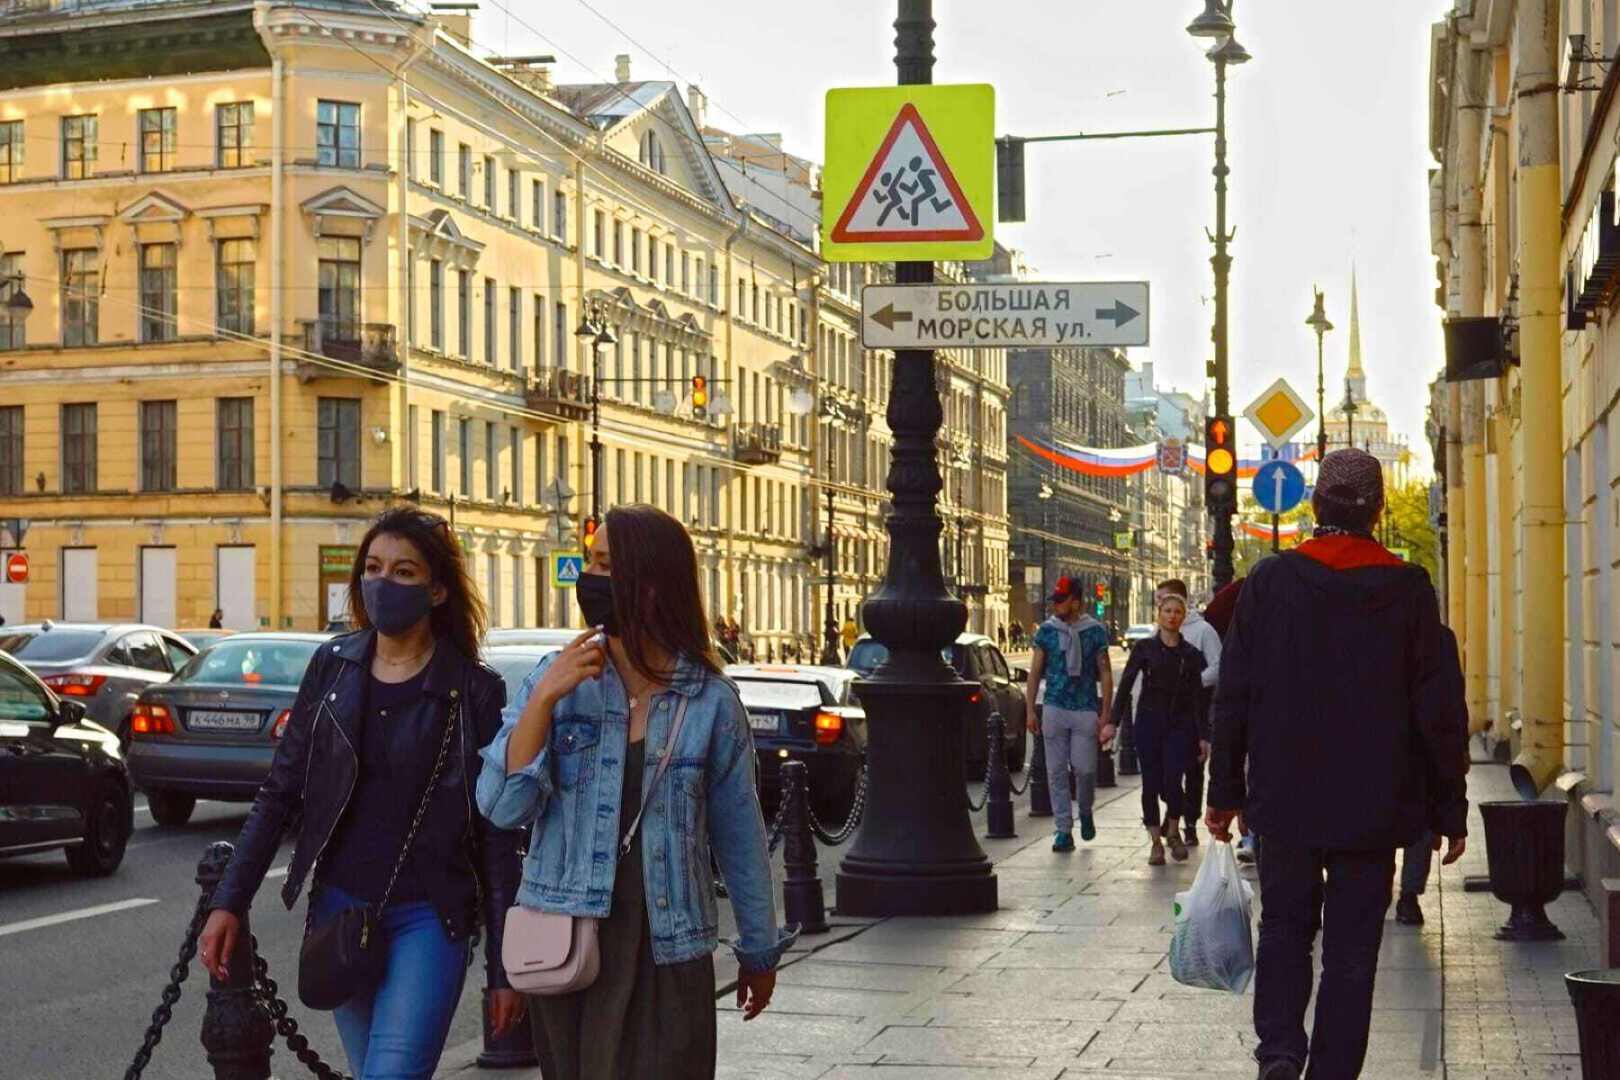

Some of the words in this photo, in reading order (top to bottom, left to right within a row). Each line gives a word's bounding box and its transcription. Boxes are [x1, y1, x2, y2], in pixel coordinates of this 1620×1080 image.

[938, 290, 1070, 311] БОЛЬШАЯ
[917, 317, 1047, 339] МОРСКАЯ
[1055, 322, 1091, 342] ул.
